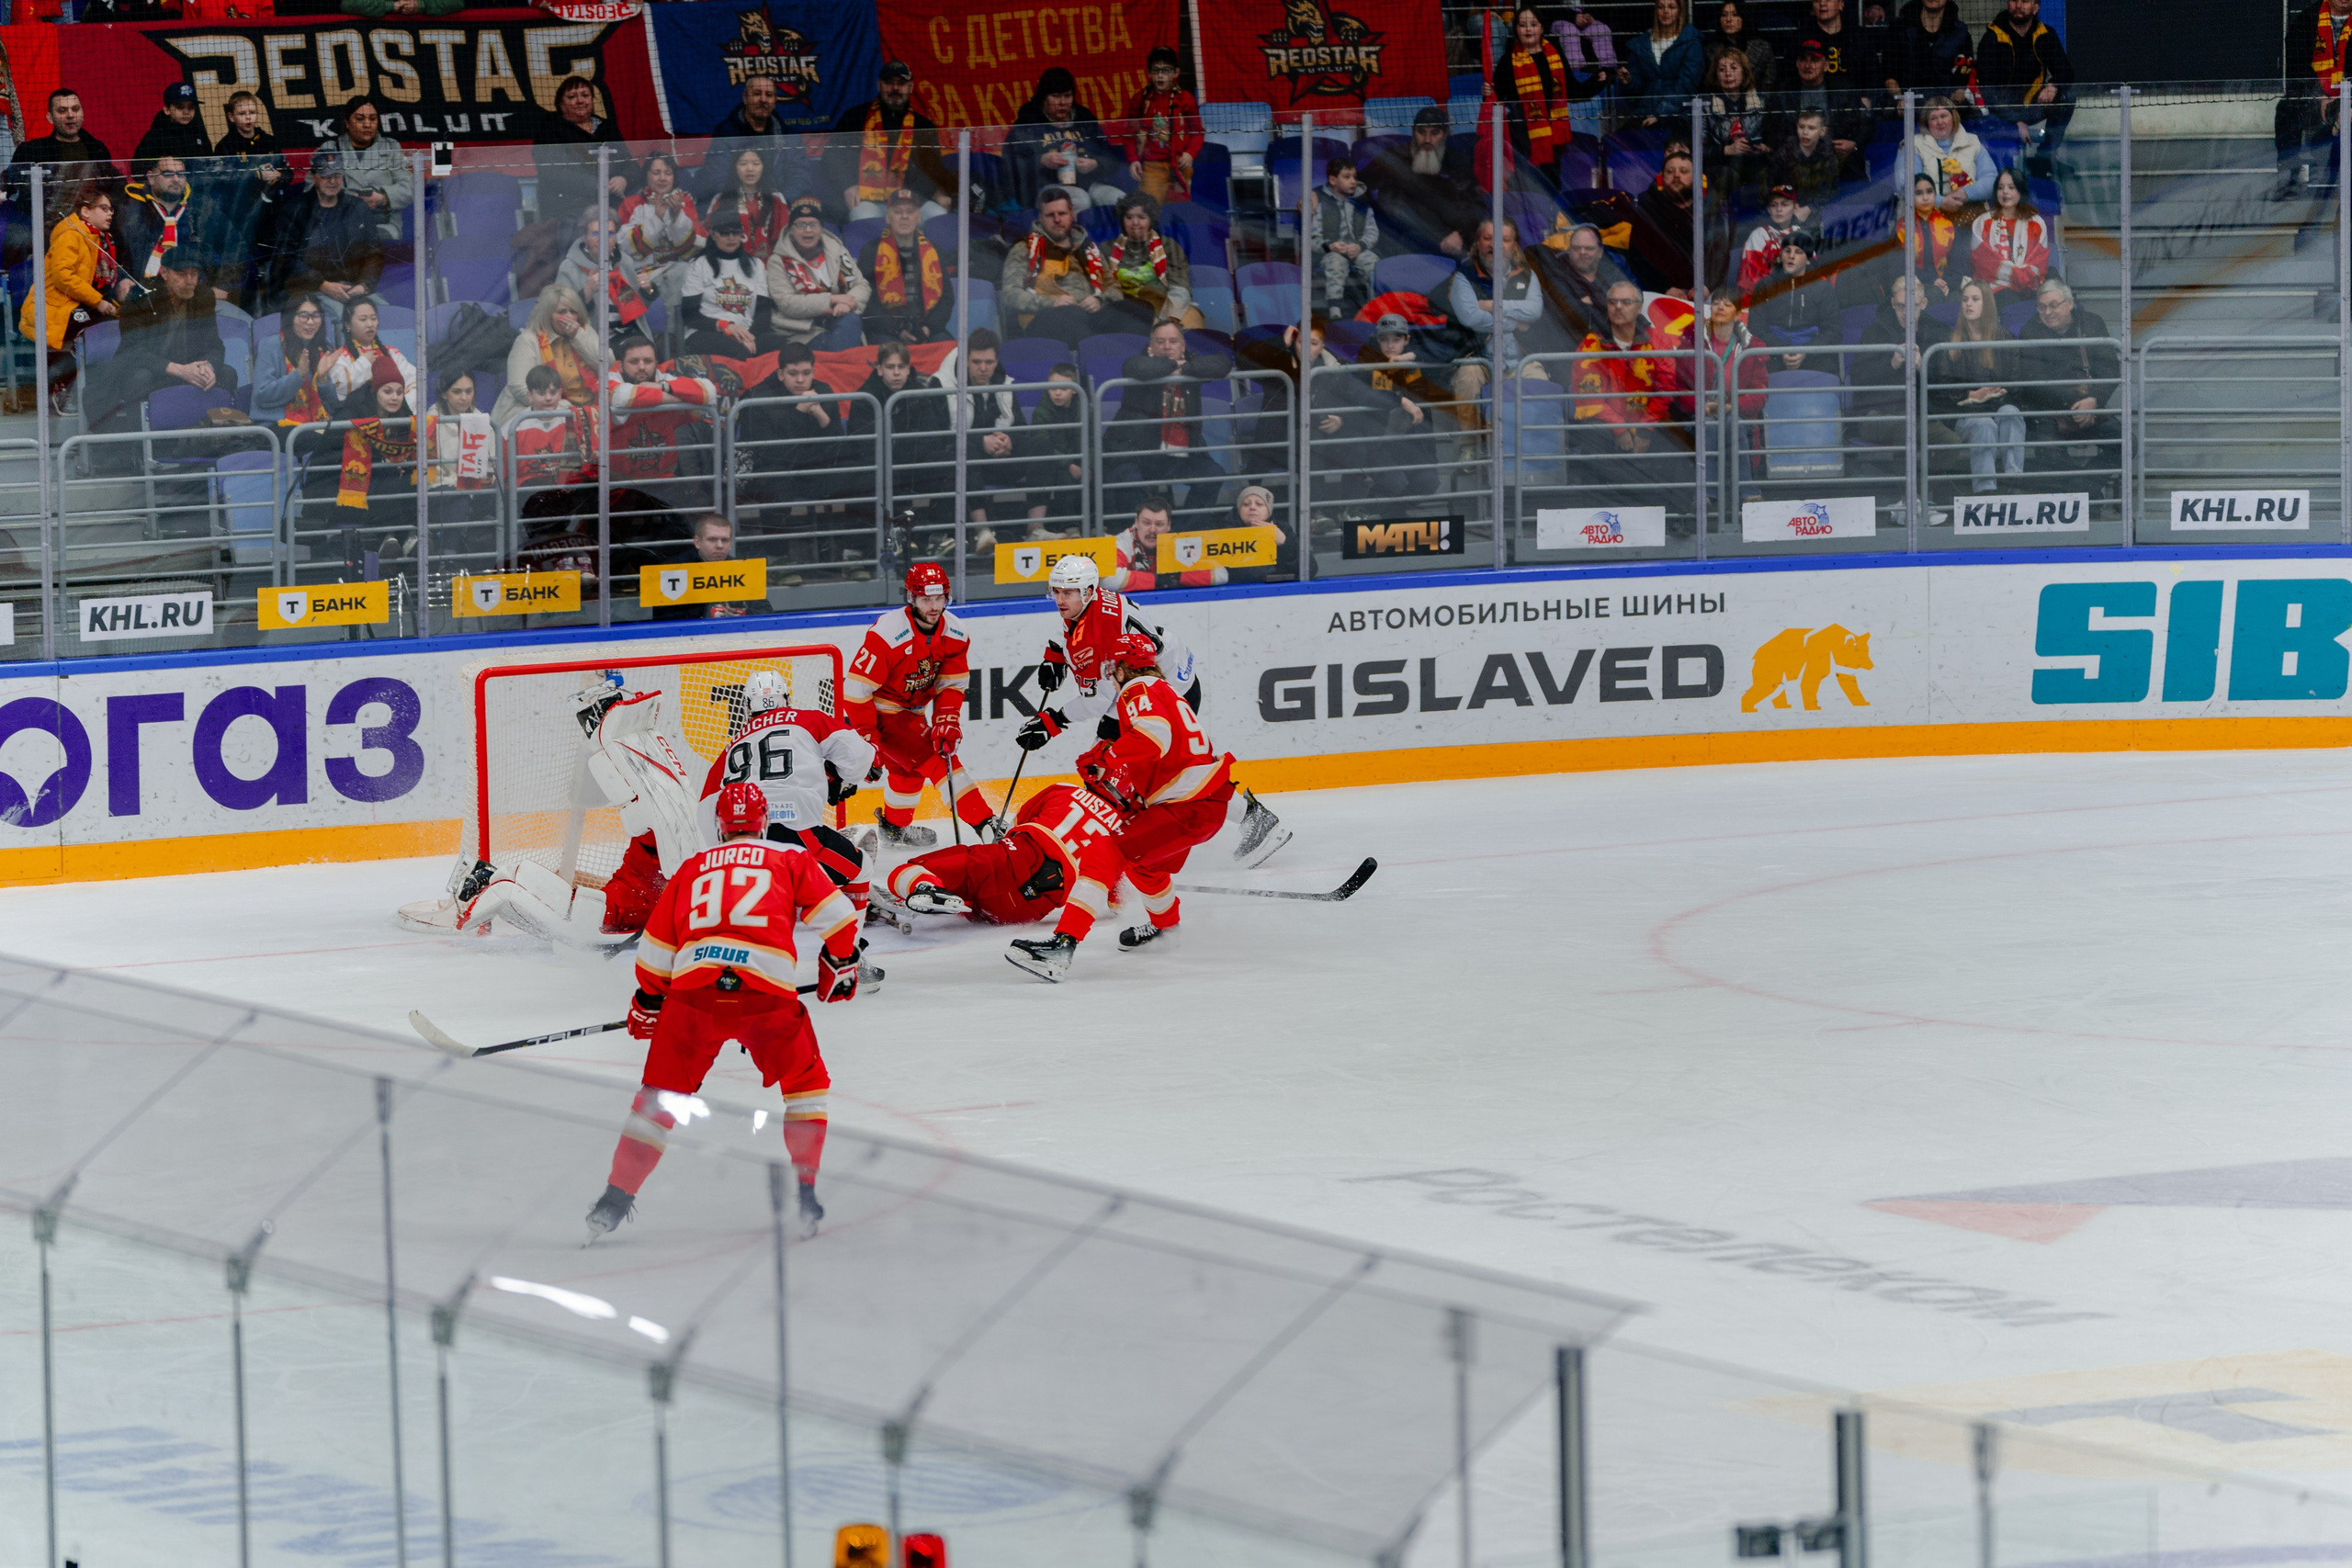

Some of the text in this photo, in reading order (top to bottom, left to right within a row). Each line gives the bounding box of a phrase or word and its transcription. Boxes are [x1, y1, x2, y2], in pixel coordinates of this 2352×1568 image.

[929, 3, 1133, 70] С ДЕТСТВА
[723, 55, 820, 86] REDSTAR
[1264, 46, 1382, 77] REDSTAR
[164, 23, 609, 152] REDSTAR
[919, 80, 971, 130] ЗА
[296, 110, 514, 137] KNLUN
[460, 429, 487, 474] TAR
[1787, 516, 1816, 527] АВТО
[1962, 500, 2080, 527] KHL.RU
[2179, 497, 2301, 522] KHL.RU
[1357, 521, 1451, 554] МАТЧ!
[1579, 525, 1609, 536] АВТО
[1588, 533, 1624, 545] РАДИО
[1795, 525, 1833, 536] РАДИО
[1206, 540, 1258, 557] БАНК
[505, 585, 560, 602] БАНК
[692, 574, 746, 590] БАНК
[89, 600, 205, 633] KHL.RU
[311, 596, 367, 613] БАНК
[1328, 592, 1725, 634] АВТОМОБИЛЬНЫЕ ШИНЫ
[2031, 578, 2352, 705] SIB
[854, 647, 877, 674] 21
[1258, 644, 1724, 723] GISLAVED
[1125, 695, 1153, 721] 94
[725, 711, 798, 752] OUCHER
[1176, 699, 1210, 755] 9
[0, 677, 424, 828] огаз
[656, 736, 687, 776] CCM
[732, 803, 746, 816] 92
[699, 847, 764, 873] JURCO
[689, 866, 772, 931] 92
[694, 945, 750, 964] SIBUR
